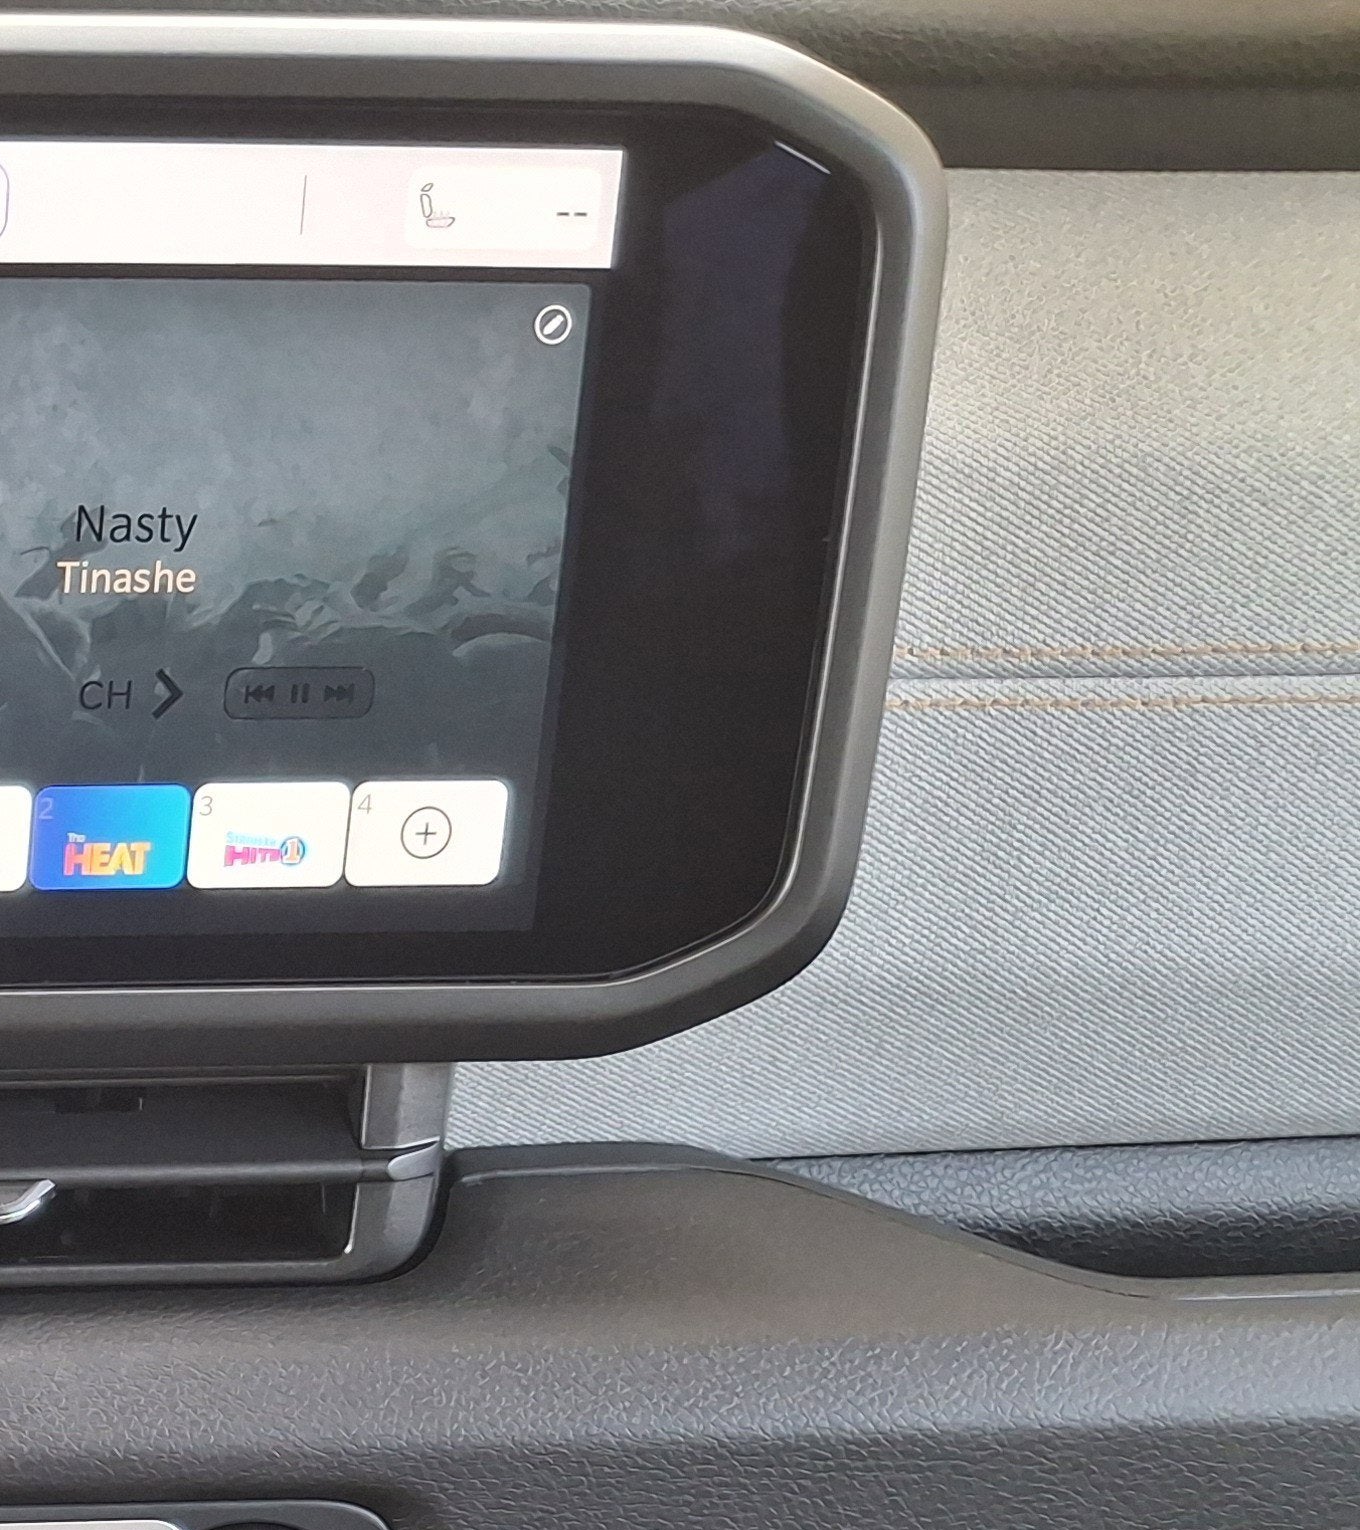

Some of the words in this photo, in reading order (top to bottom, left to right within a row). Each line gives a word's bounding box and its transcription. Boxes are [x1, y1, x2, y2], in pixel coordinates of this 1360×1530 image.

[73, 504, 199, 551] Nasty
[55, 559, 198, 597] Tinashe
[79, 680, 134, 711] CH
[38, 797, 55, 819] 2
[199, 795, 214, 816] 3
[357, 793, 373, 815] 4
[63, 841, 153, 876] HEAT
